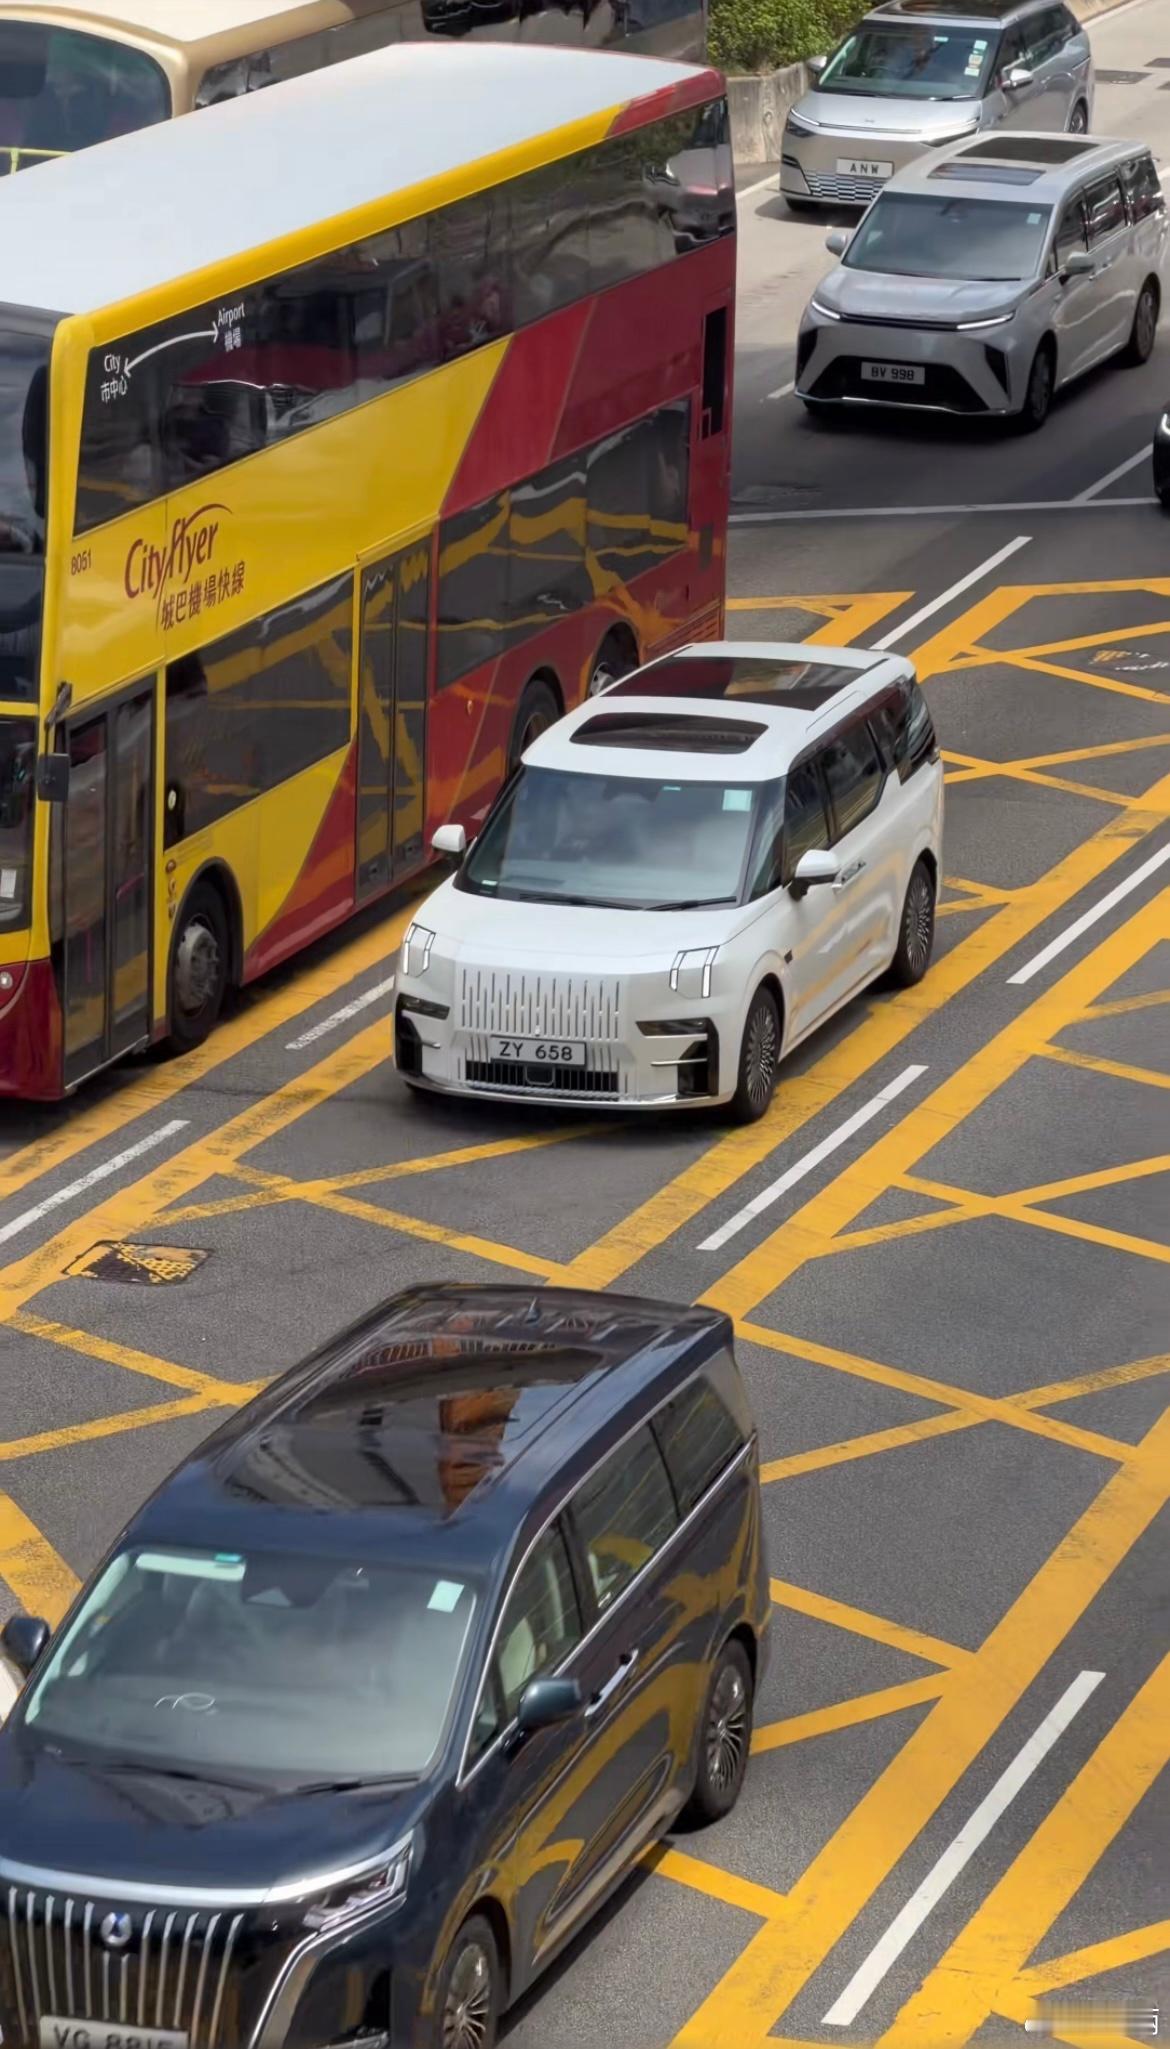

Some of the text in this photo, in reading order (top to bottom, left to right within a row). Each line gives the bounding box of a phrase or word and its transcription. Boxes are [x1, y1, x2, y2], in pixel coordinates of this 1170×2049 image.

[849, 163, 880, 175] ANW
[218, 302, 245, 327] Airport
[104, 354, 121, 374] City
[871, 366, 886, 377] BV
[100, 375, 128, 403] 市中心
[71, 548, 92, 576] 8051
[160, 560, 245, 631] 城巴機場快線
[499, 1041, 573, 1061] ZY 658
